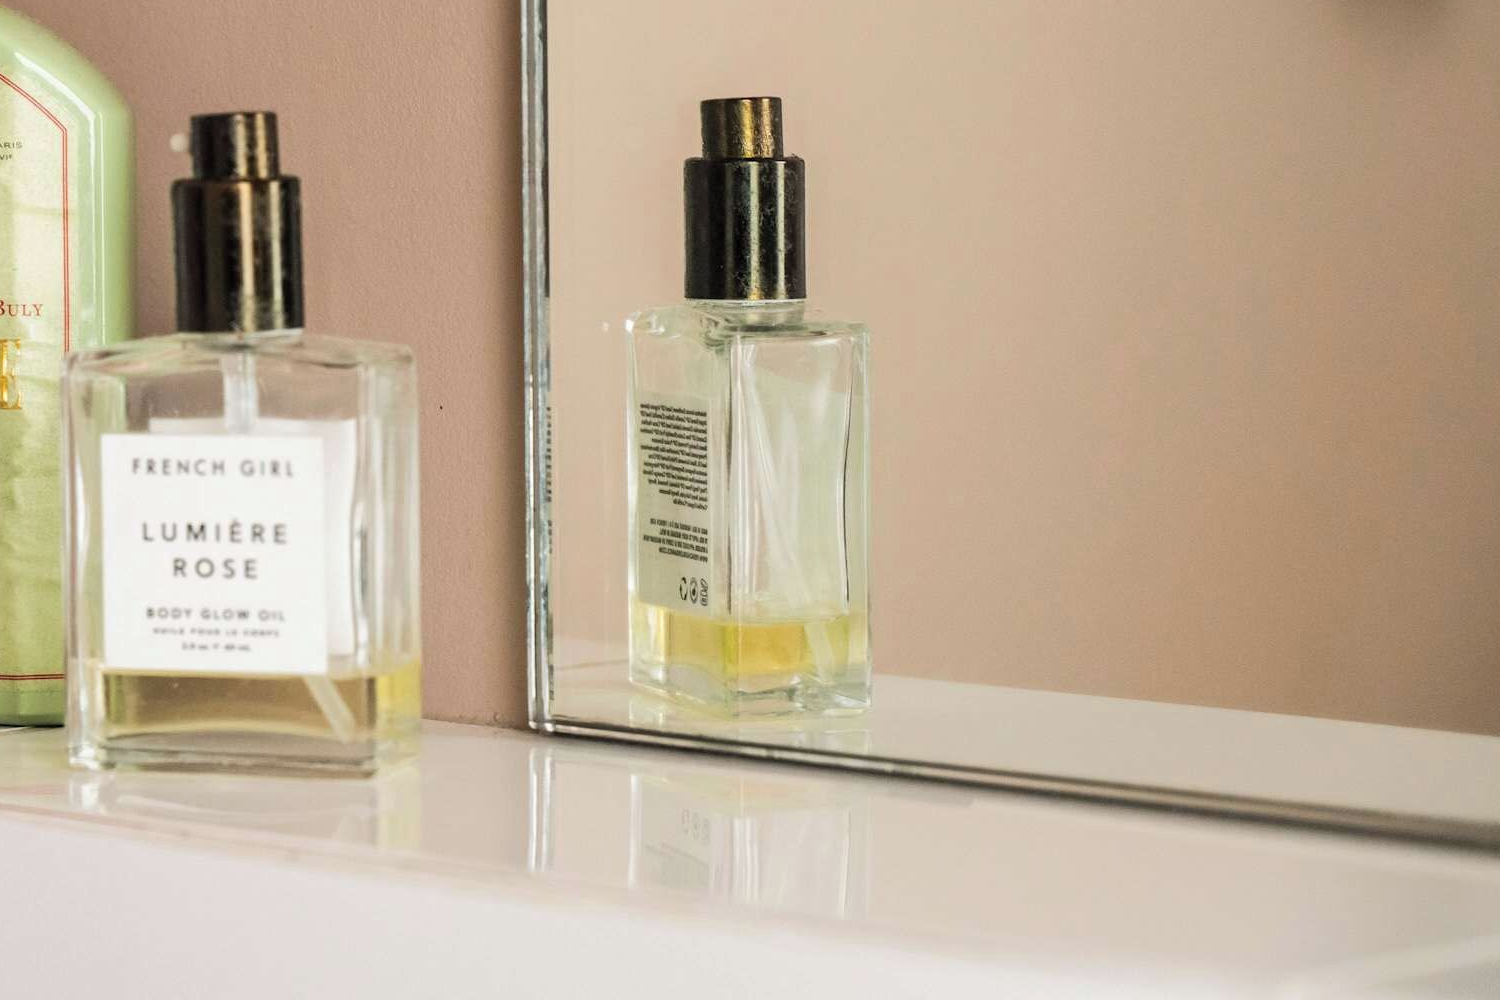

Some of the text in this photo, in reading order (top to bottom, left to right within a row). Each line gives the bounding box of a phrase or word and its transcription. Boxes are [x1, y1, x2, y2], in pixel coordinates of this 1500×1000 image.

[131, 457, 295, 478] FRENCH GIRL
[141, 519, 288, 545] LUMIÈRE
[171, 557, 259, 580] ROSE
[146, 607, 286, 622] BODY GLOW OIL
